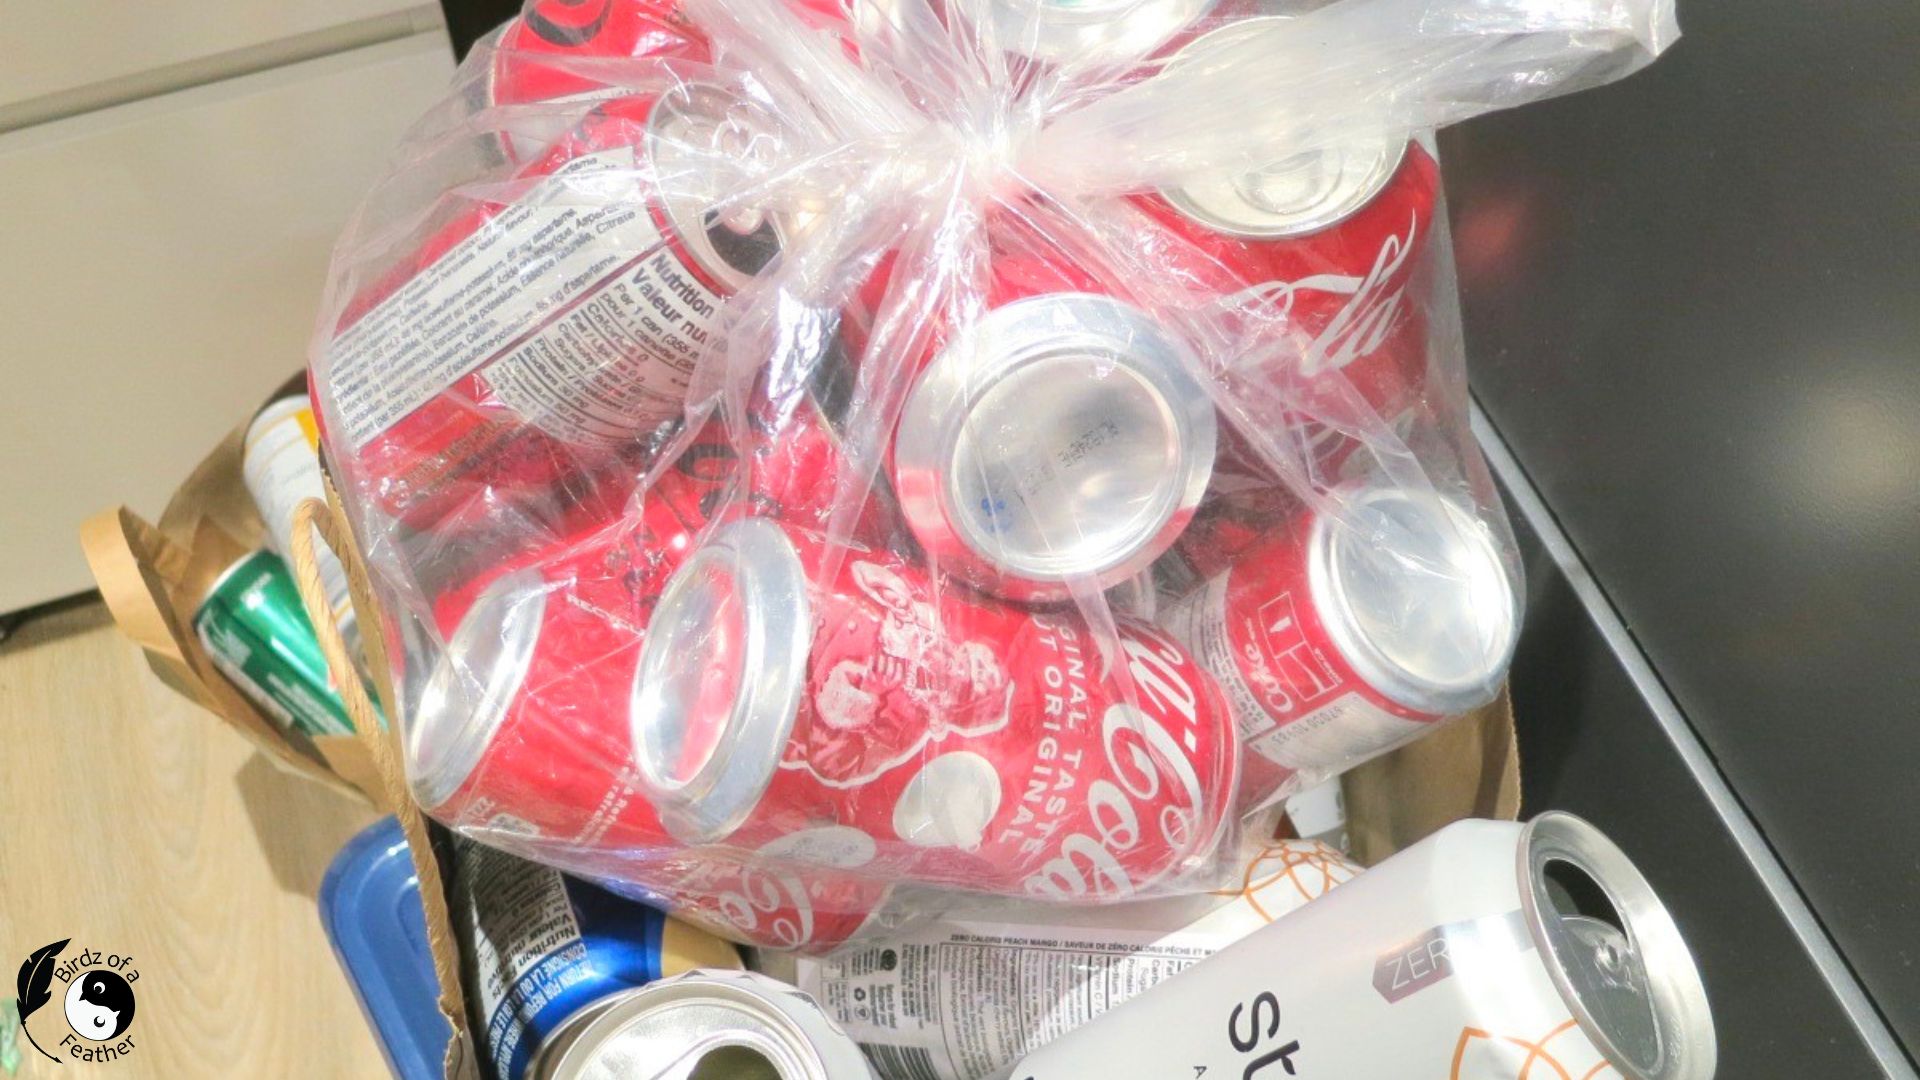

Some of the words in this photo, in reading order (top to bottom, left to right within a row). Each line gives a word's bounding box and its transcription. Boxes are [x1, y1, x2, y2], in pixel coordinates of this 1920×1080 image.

[599, 292, 625, 321] pour
[613, 282, 636, 307] Per
[639, 315, 663, 337] can
[630, 267, 683, 325] Valeur
[650, 252, 716, 319] Nutrition
[1059, 626, 1083, 729] GINAL
[1244, 643, 1294, 716] Coke
[997, 664, 1060, 849] ORIGINAL
[1026, 748, 1083, 852] TASTE
[517, 924, 576, 966] Nutrition
[527, 912, 571, 942] Valeur
[1030, 938, 1058, 946] MANGO
[1064, 940, 1093, 949] SAVEUR
[1126, 958, 1134, 993] Protein
[1166, 960, 1174, 975] Fat
[1384, 937, 1450, 991] ZER
